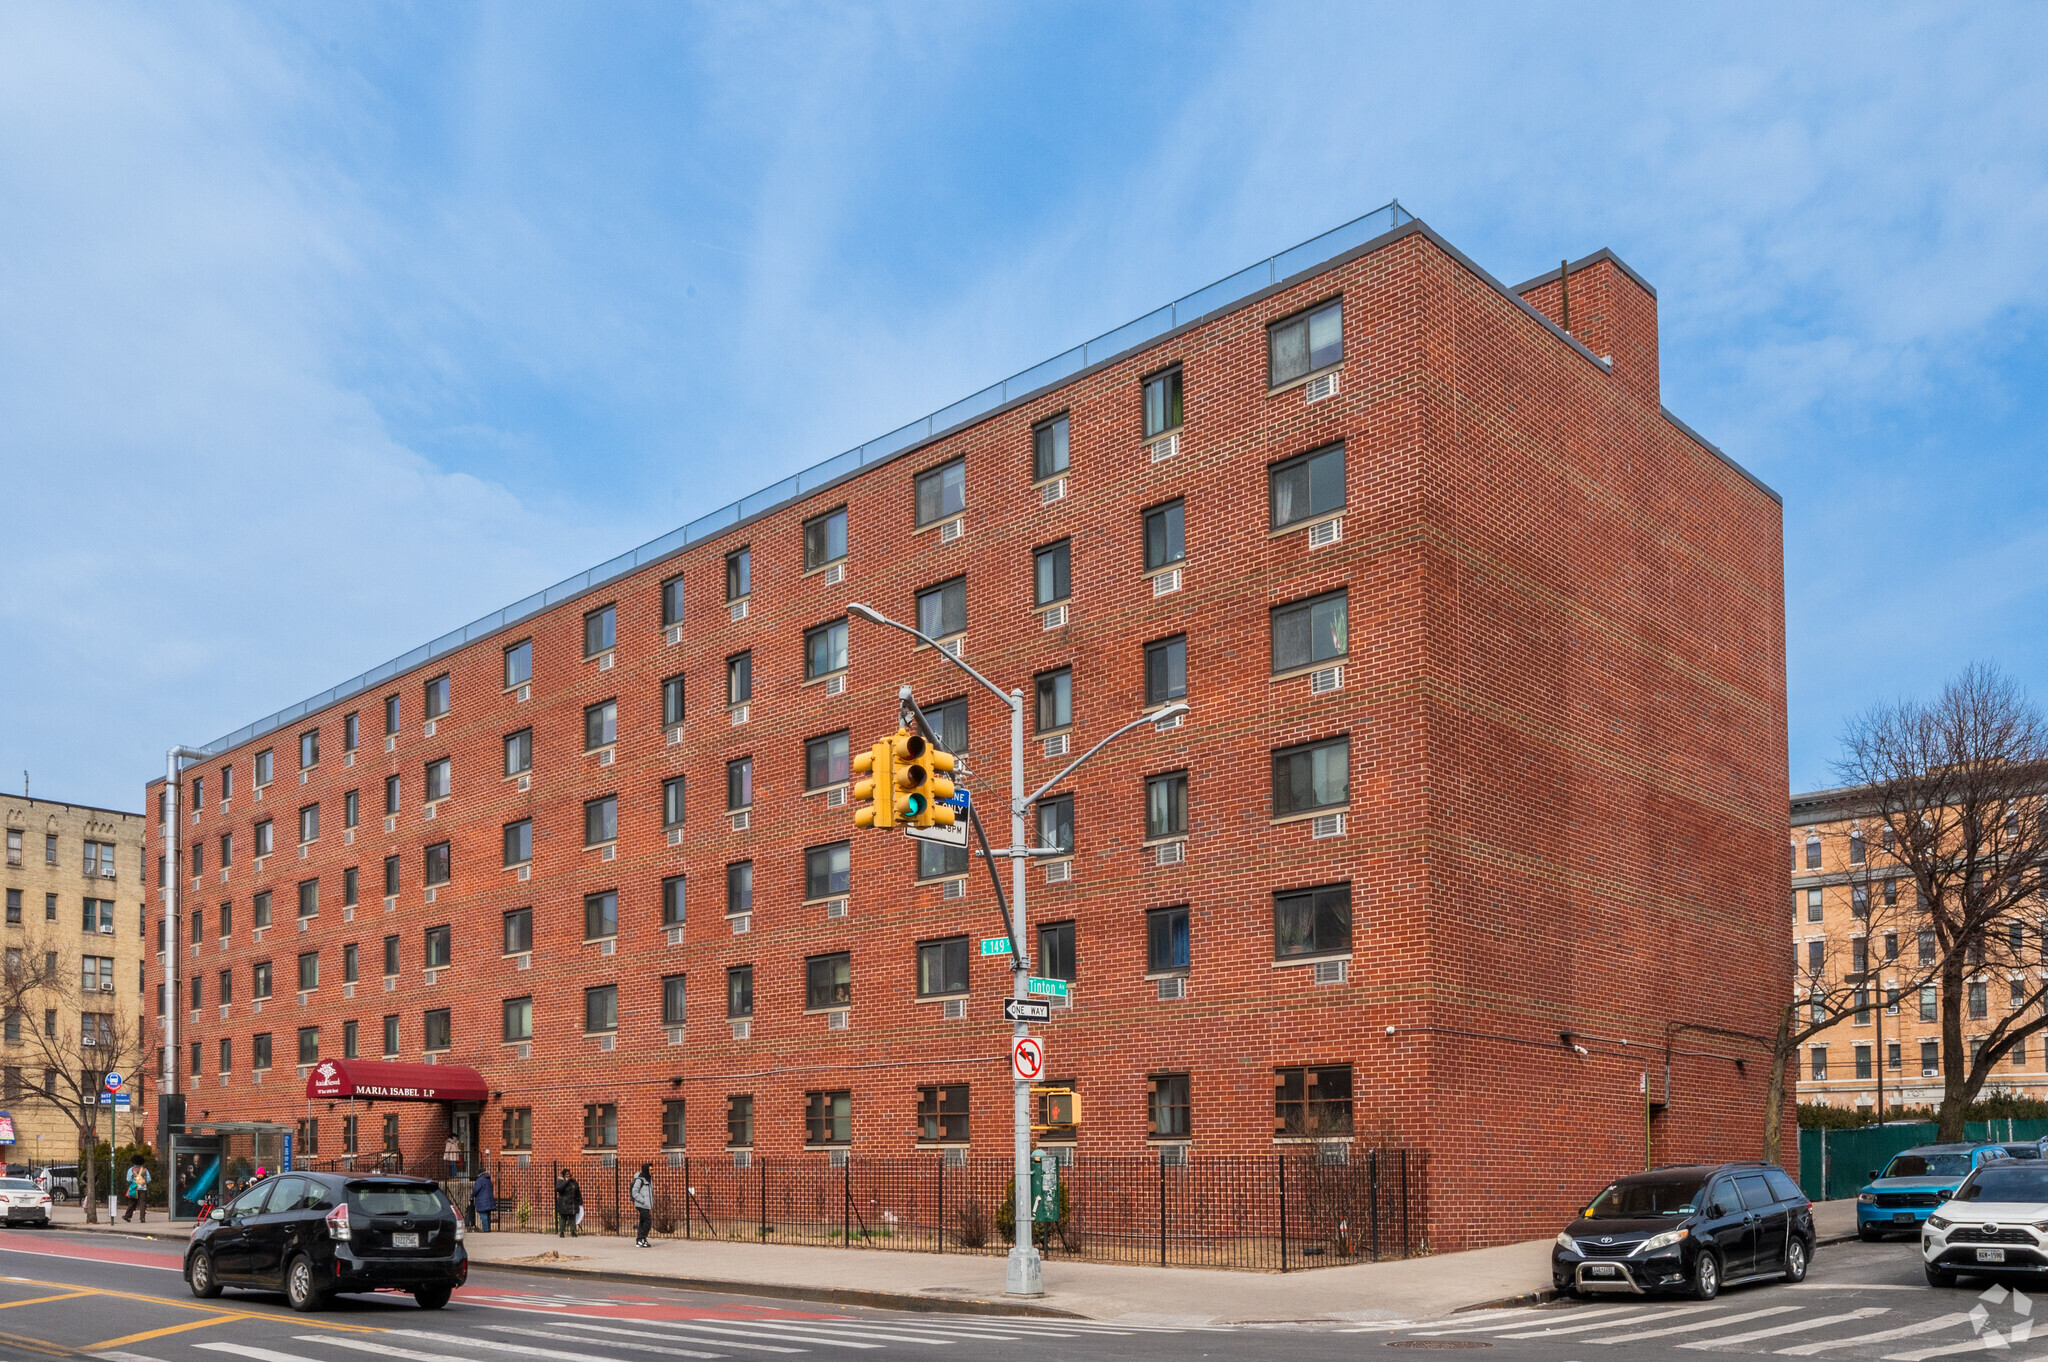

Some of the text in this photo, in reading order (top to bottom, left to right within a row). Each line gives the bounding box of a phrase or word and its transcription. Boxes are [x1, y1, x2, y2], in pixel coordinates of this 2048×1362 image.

[982, 941, 987, 954] E
[990, 940, 1005, 953] 149
[1029, 980, 1056, 994] Tinton
[1011, 1005, 1045, 1015] ONE WAY
[356, 1086, 388, 1095] MARIA
[390, 1088, 419, 1096] ISABEL
